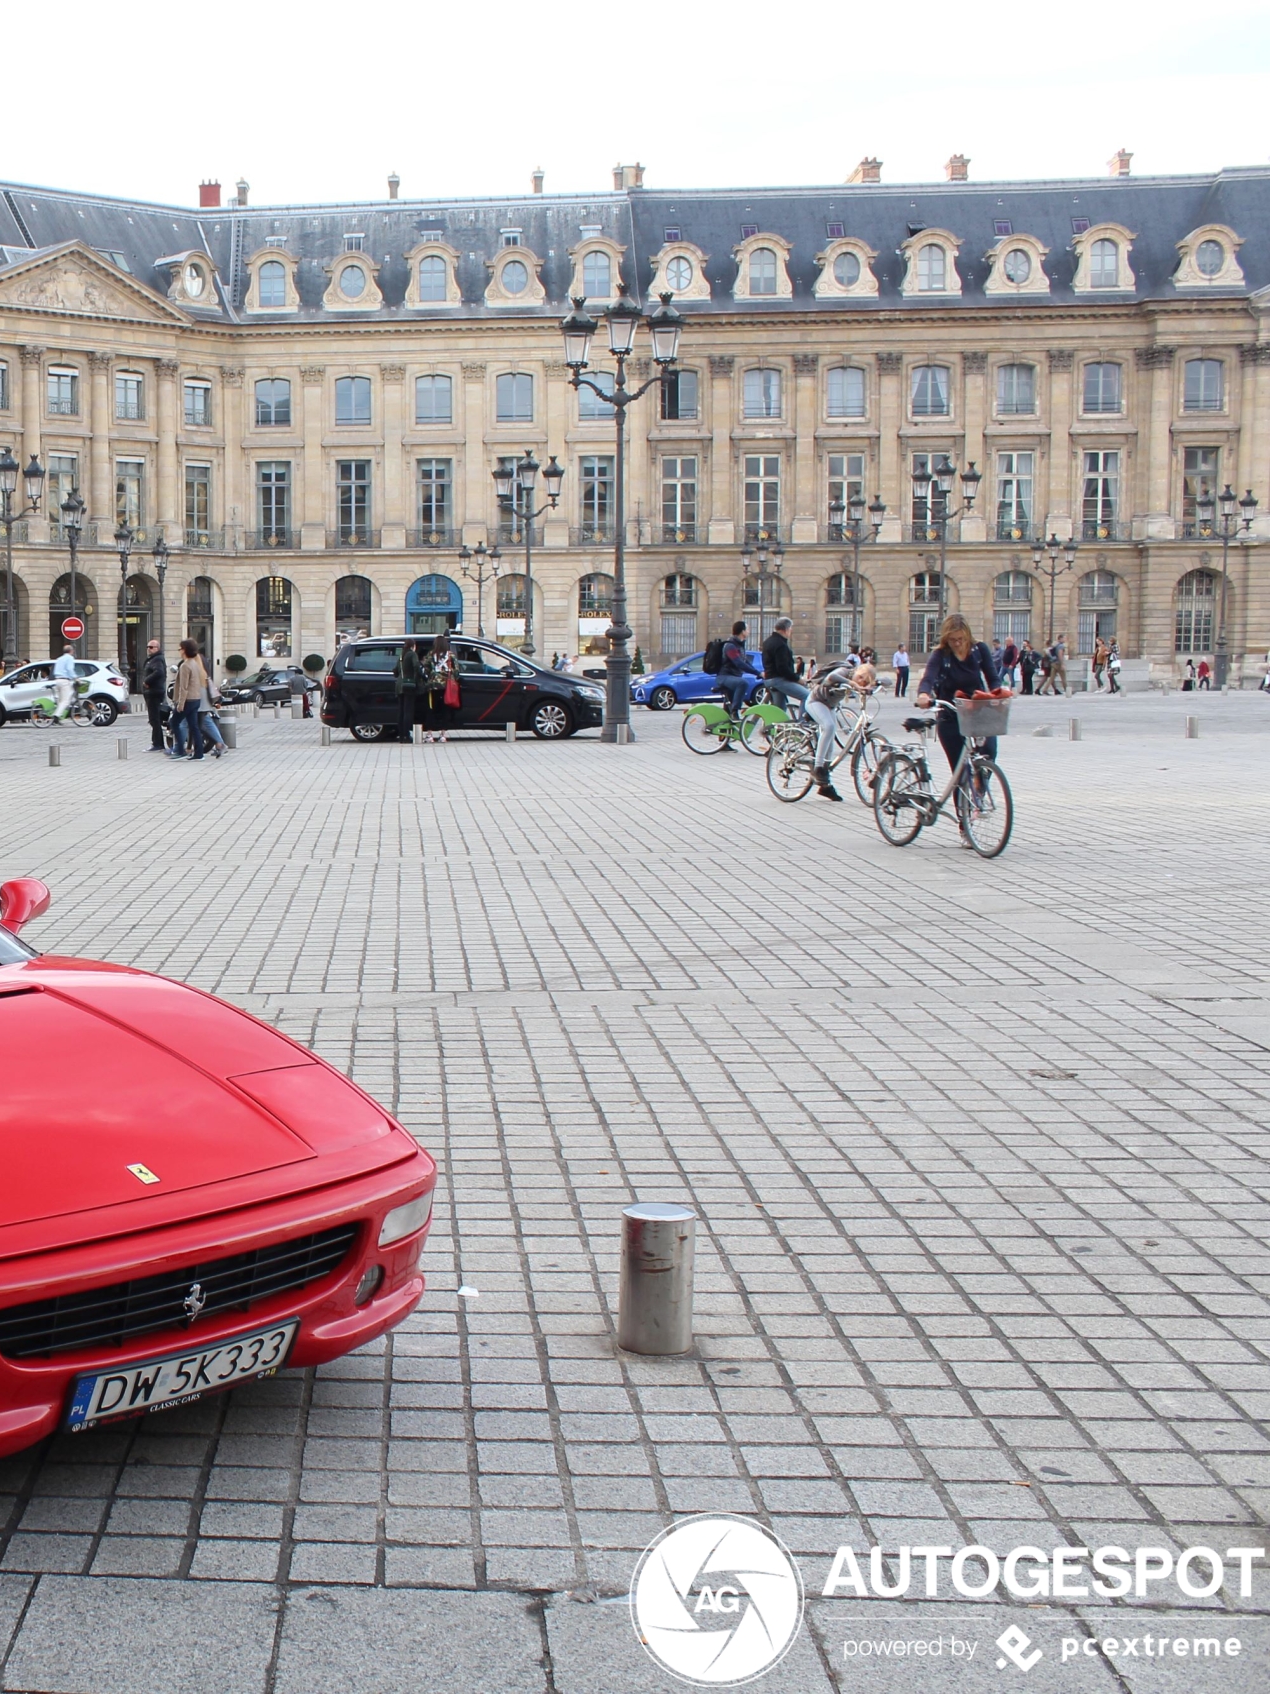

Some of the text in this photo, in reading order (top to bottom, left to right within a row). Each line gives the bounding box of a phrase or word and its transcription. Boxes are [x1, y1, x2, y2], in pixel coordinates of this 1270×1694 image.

[95, 1330, 286, 1414] DW 5K333
[71, 1404, 85, 1416] PL
[150, 1392, 201, 1412] CLASSIC CARS
